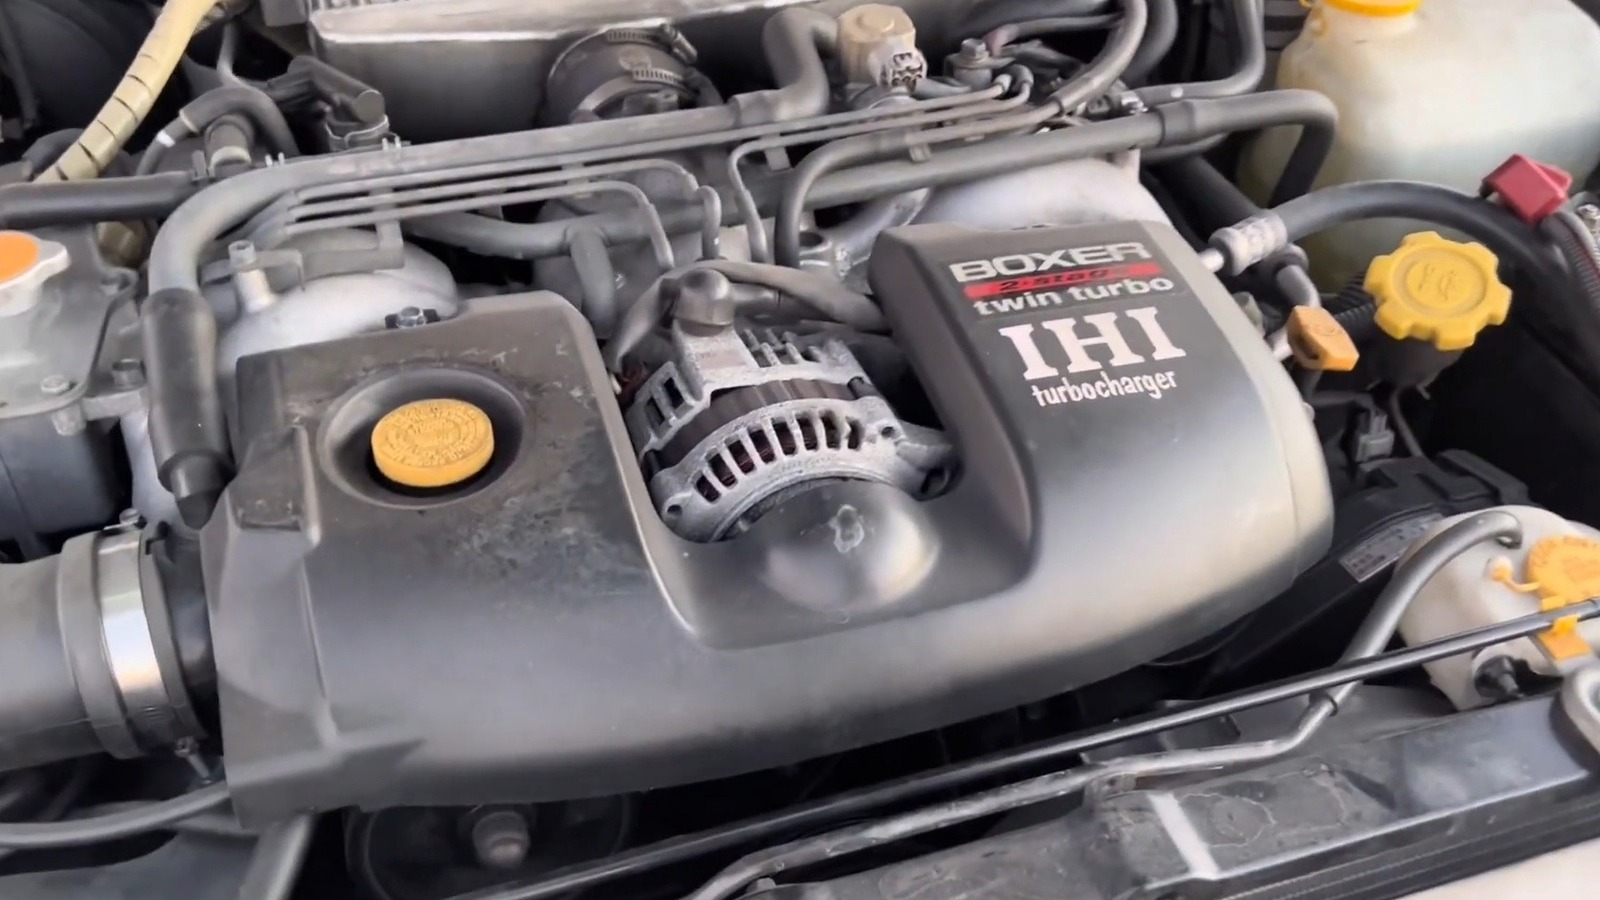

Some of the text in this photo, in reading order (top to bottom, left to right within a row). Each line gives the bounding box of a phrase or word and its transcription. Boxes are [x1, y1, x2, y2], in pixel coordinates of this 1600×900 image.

[949, 242, 1152, 282] BOXER
[973, 277, 1175, 316] twin turbo
[998, 306, 1187, 381] IHI
[1032, 370, 1178, 407] turbocharger
